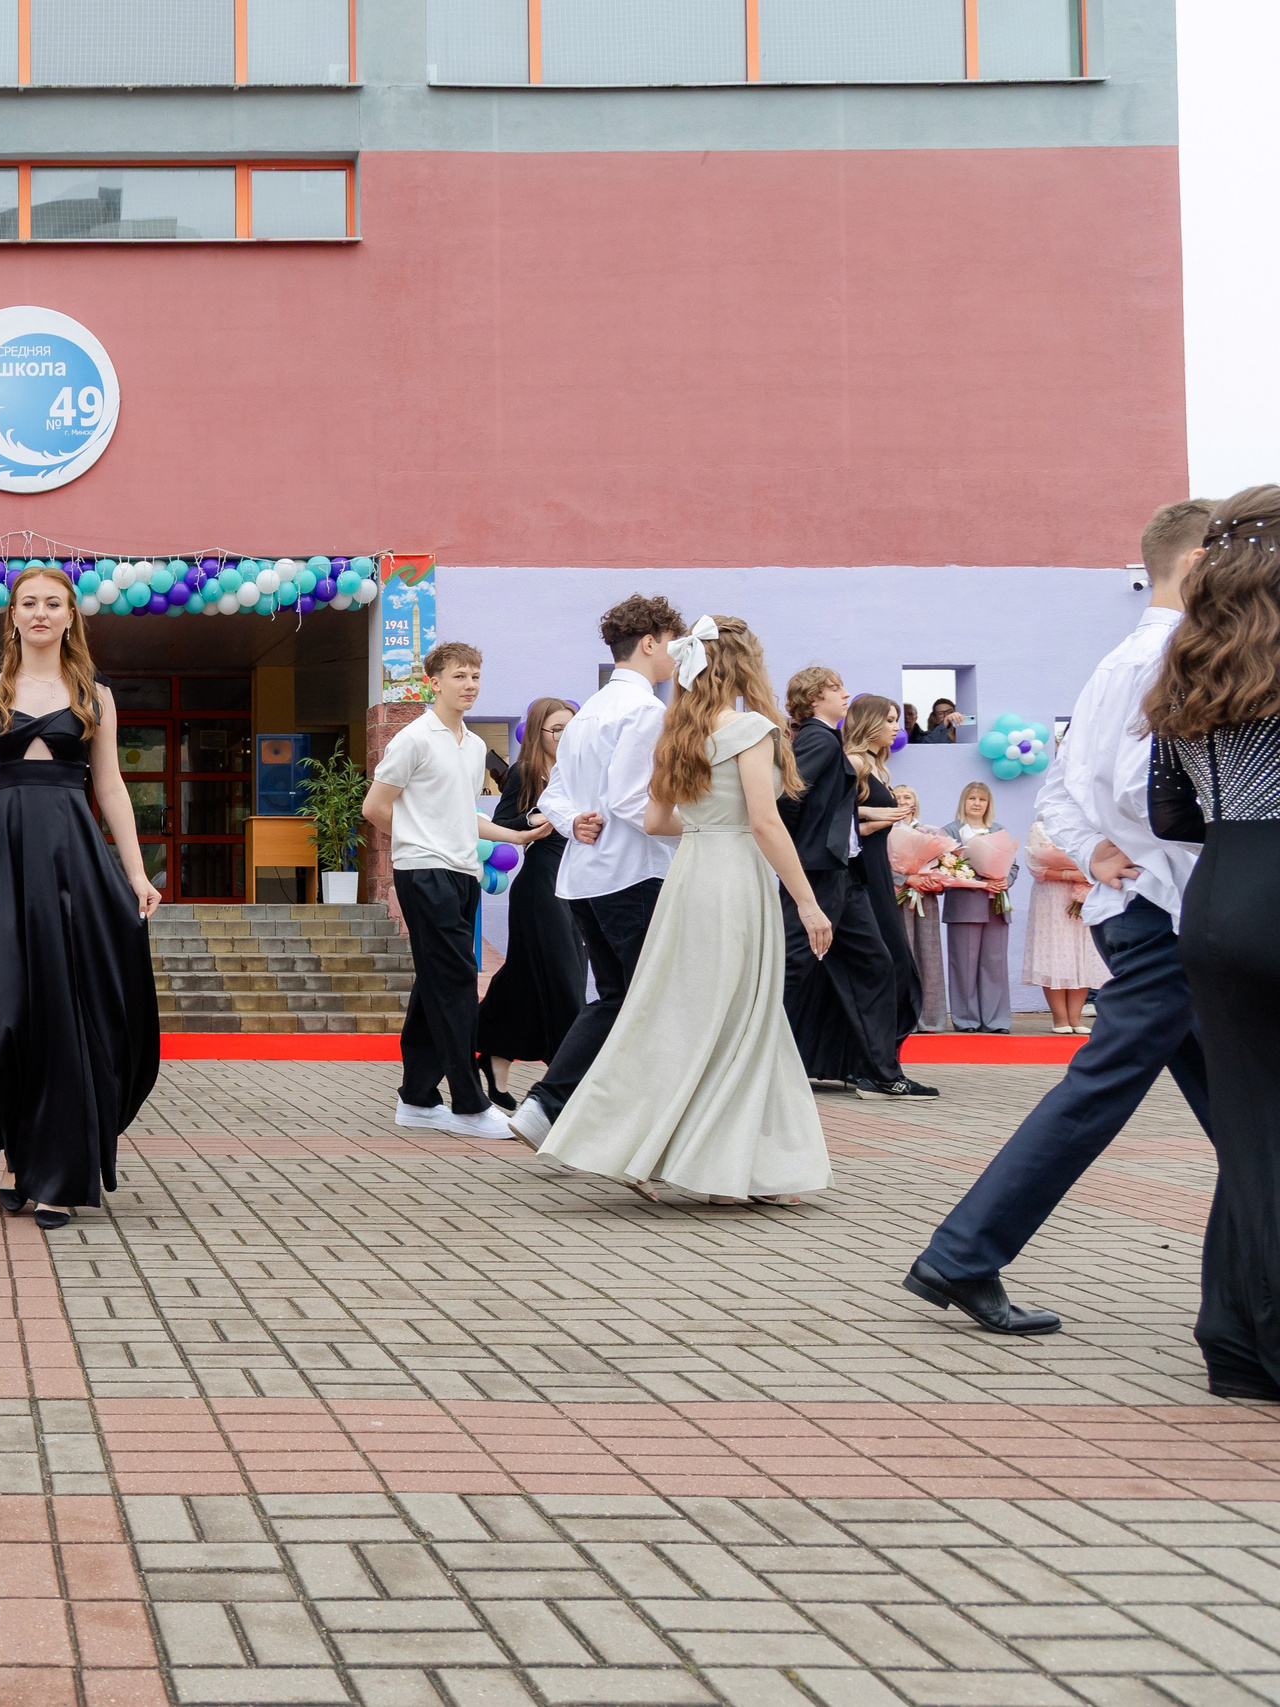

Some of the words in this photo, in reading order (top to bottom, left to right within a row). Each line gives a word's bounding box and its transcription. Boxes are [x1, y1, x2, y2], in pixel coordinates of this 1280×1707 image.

[50, 386, 103, 426] 49
[384, 620, 409, 630] 1941
[384, 636, 410, 646] 1945
